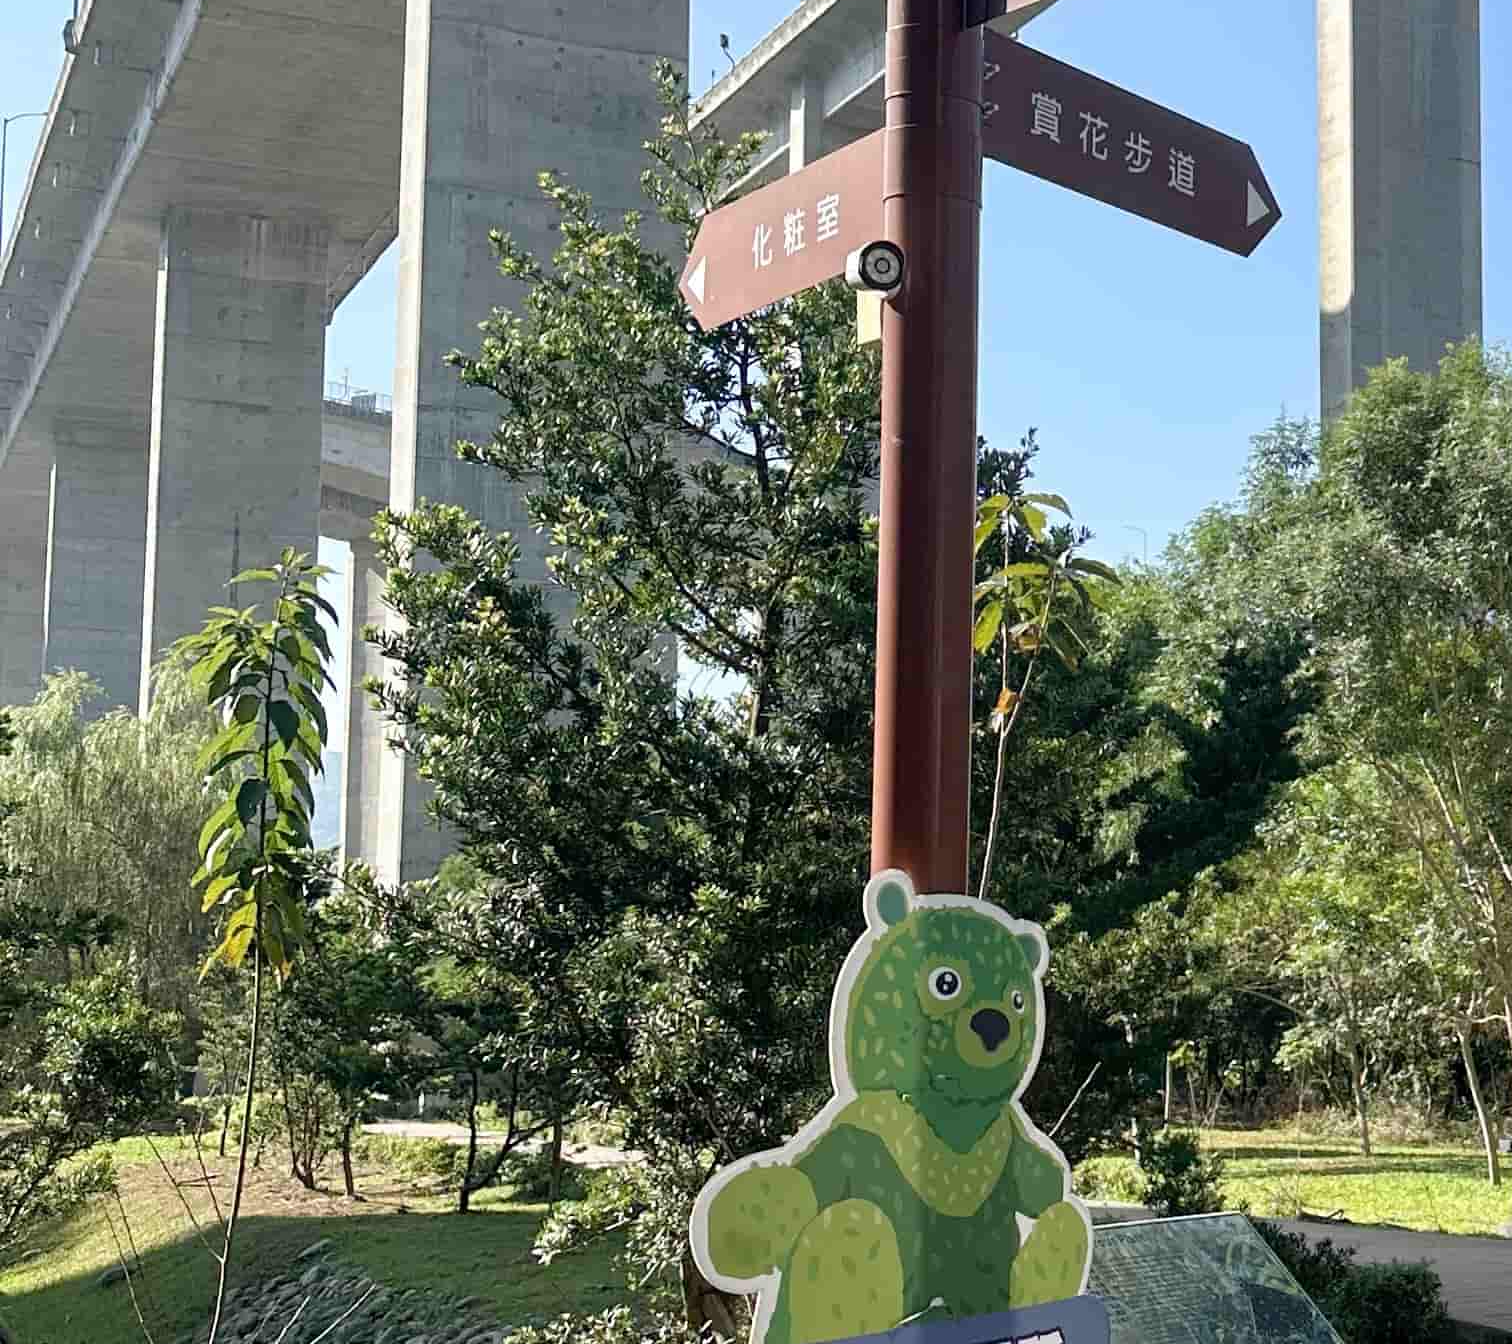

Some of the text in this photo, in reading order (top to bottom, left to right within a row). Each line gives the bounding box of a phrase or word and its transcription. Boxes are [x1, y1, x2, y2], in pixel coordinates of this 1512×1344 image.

[1030, 90, 1198, 198] 賞花步道
[751, 193, 842, 268] 化粧室
